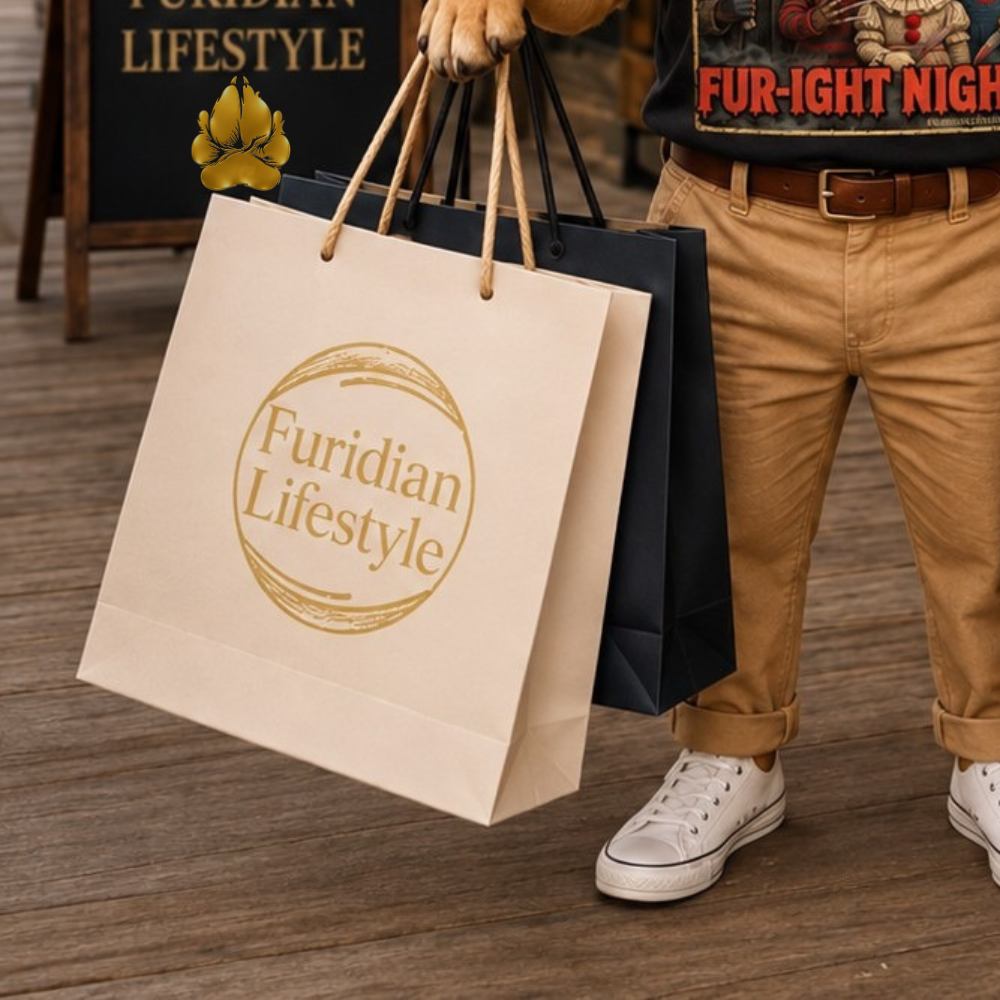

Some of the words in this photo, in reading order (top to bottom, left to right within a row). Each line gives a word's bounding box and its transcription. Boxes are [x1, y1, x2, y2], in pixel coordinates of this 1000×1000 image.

[120, 28, 366, 73] LIFESTYLE
[698, 66, 892, 119] FUR-IGHT
[258, 404, 462, 512] Furidian
[242, 467, 444, 575] Lifestyle
